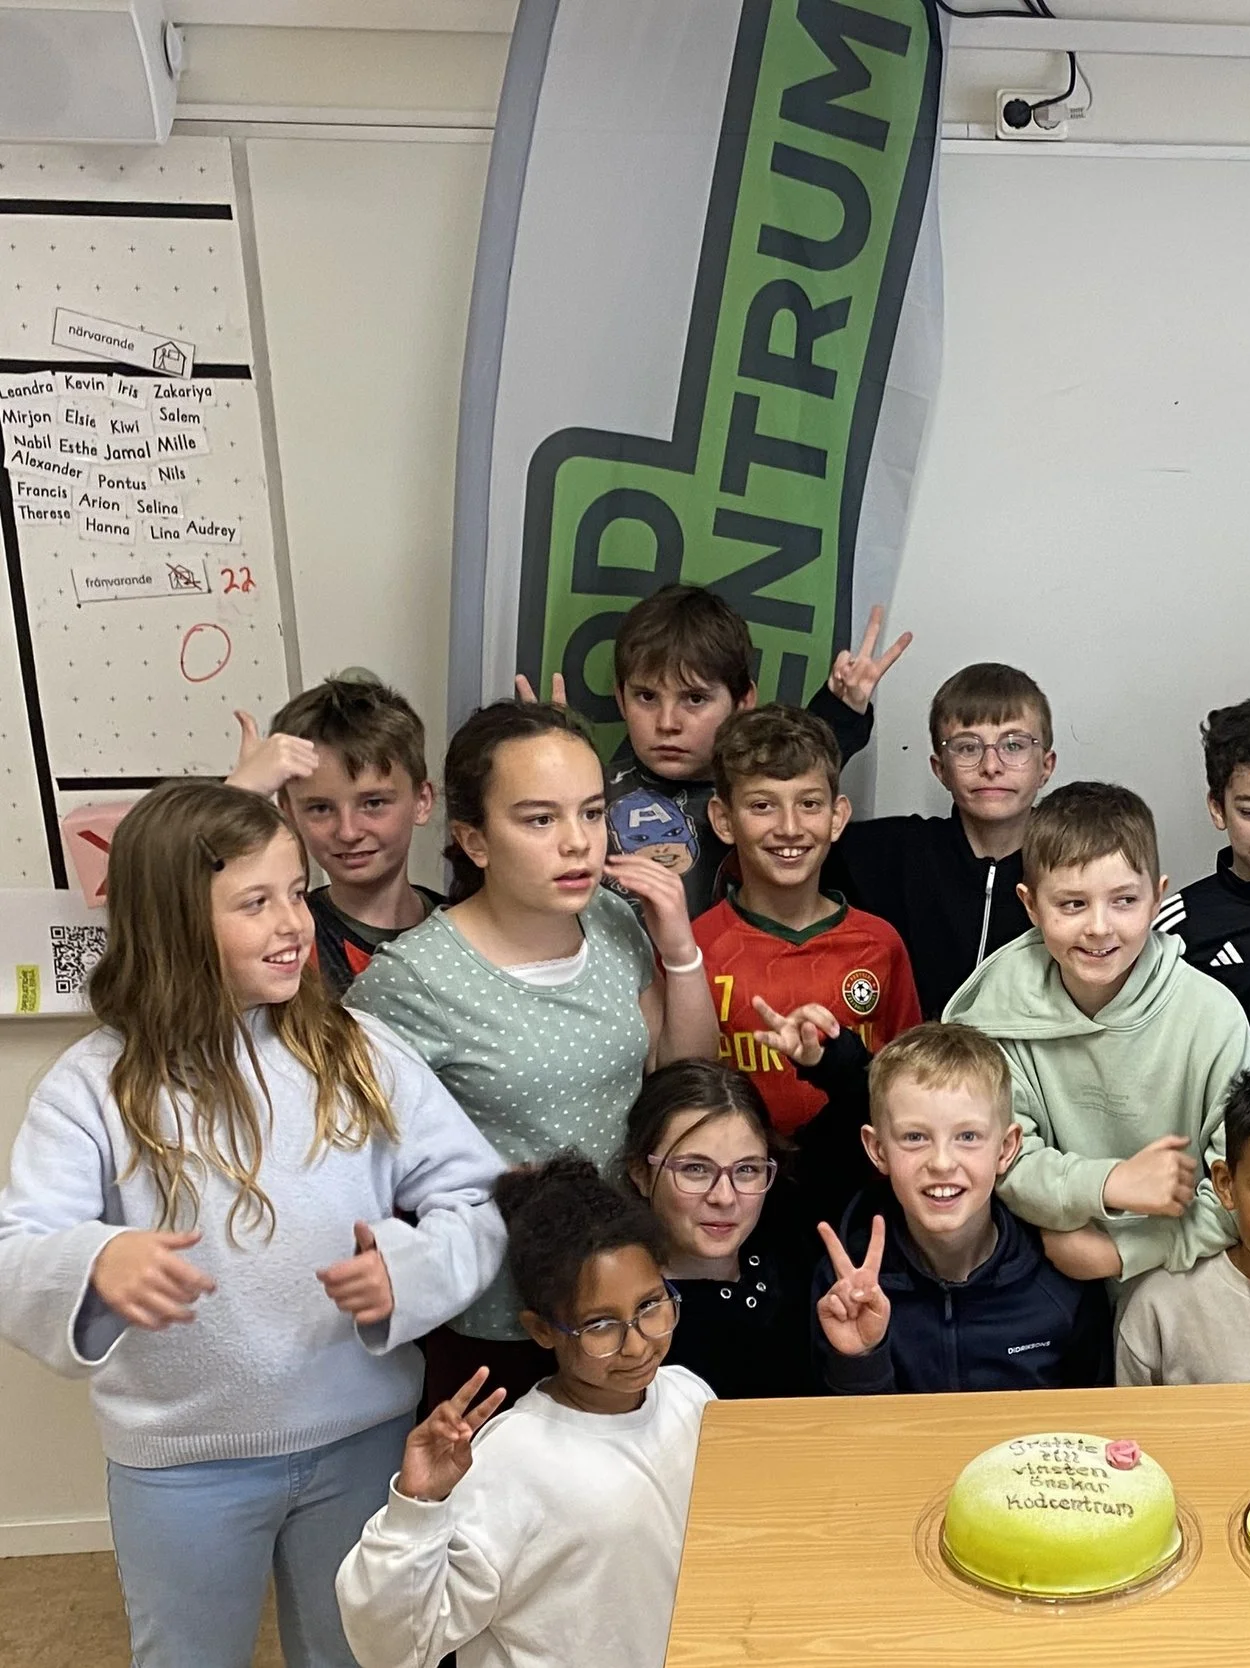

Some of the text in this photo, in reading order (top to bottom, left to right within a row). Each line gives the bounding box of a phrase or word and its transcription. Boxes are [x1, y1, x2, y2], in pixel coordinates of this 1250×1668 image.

[67, 325, 136, 352] närvarande
[712, 0, 912, 706] NTRUM
[0, 379, 54, 399] Leandra
[64, 375, 105, 391] Kevin
[117, 380, 139, 399] Iris
[153, 384, 213, 403] Zakariya
[2, 409, 52, 428] Mirjon
[65, 408, 97, 428] Elsie
[159, 407, 201, 425] Salem
[110, 419, 140, 435] Kiwi
[14, 433, 52, 450] Nabil
[104, 440, 151, 461] Jamal
[157, 438, 197, 454] Mille
[11, 449, 83, 480] Alexander
[98, 474, 147, 491] Pontus
[158, 467, 186, 483] Nils
[18, 482, 67, 500] Francis
[79, 493, 120, 512] Arion
[137, 500, 178, 515] Selina
[18, 505, 71, 521] Therese
[86, 517, 130, 537] Hanna
[151, 525, 180, 540] Lina
[187, 520, 236, 543] Audrey
[85, 575, 152, 590] frånvarande
[221, 567, 256, 593] 22
[561, 487, 684, 724] OD
[714, 975, 734, 1022] 7
[1012, 1462, 1110, 1479] vinsten
[1030, 1476, 1109, 1493] önskar
